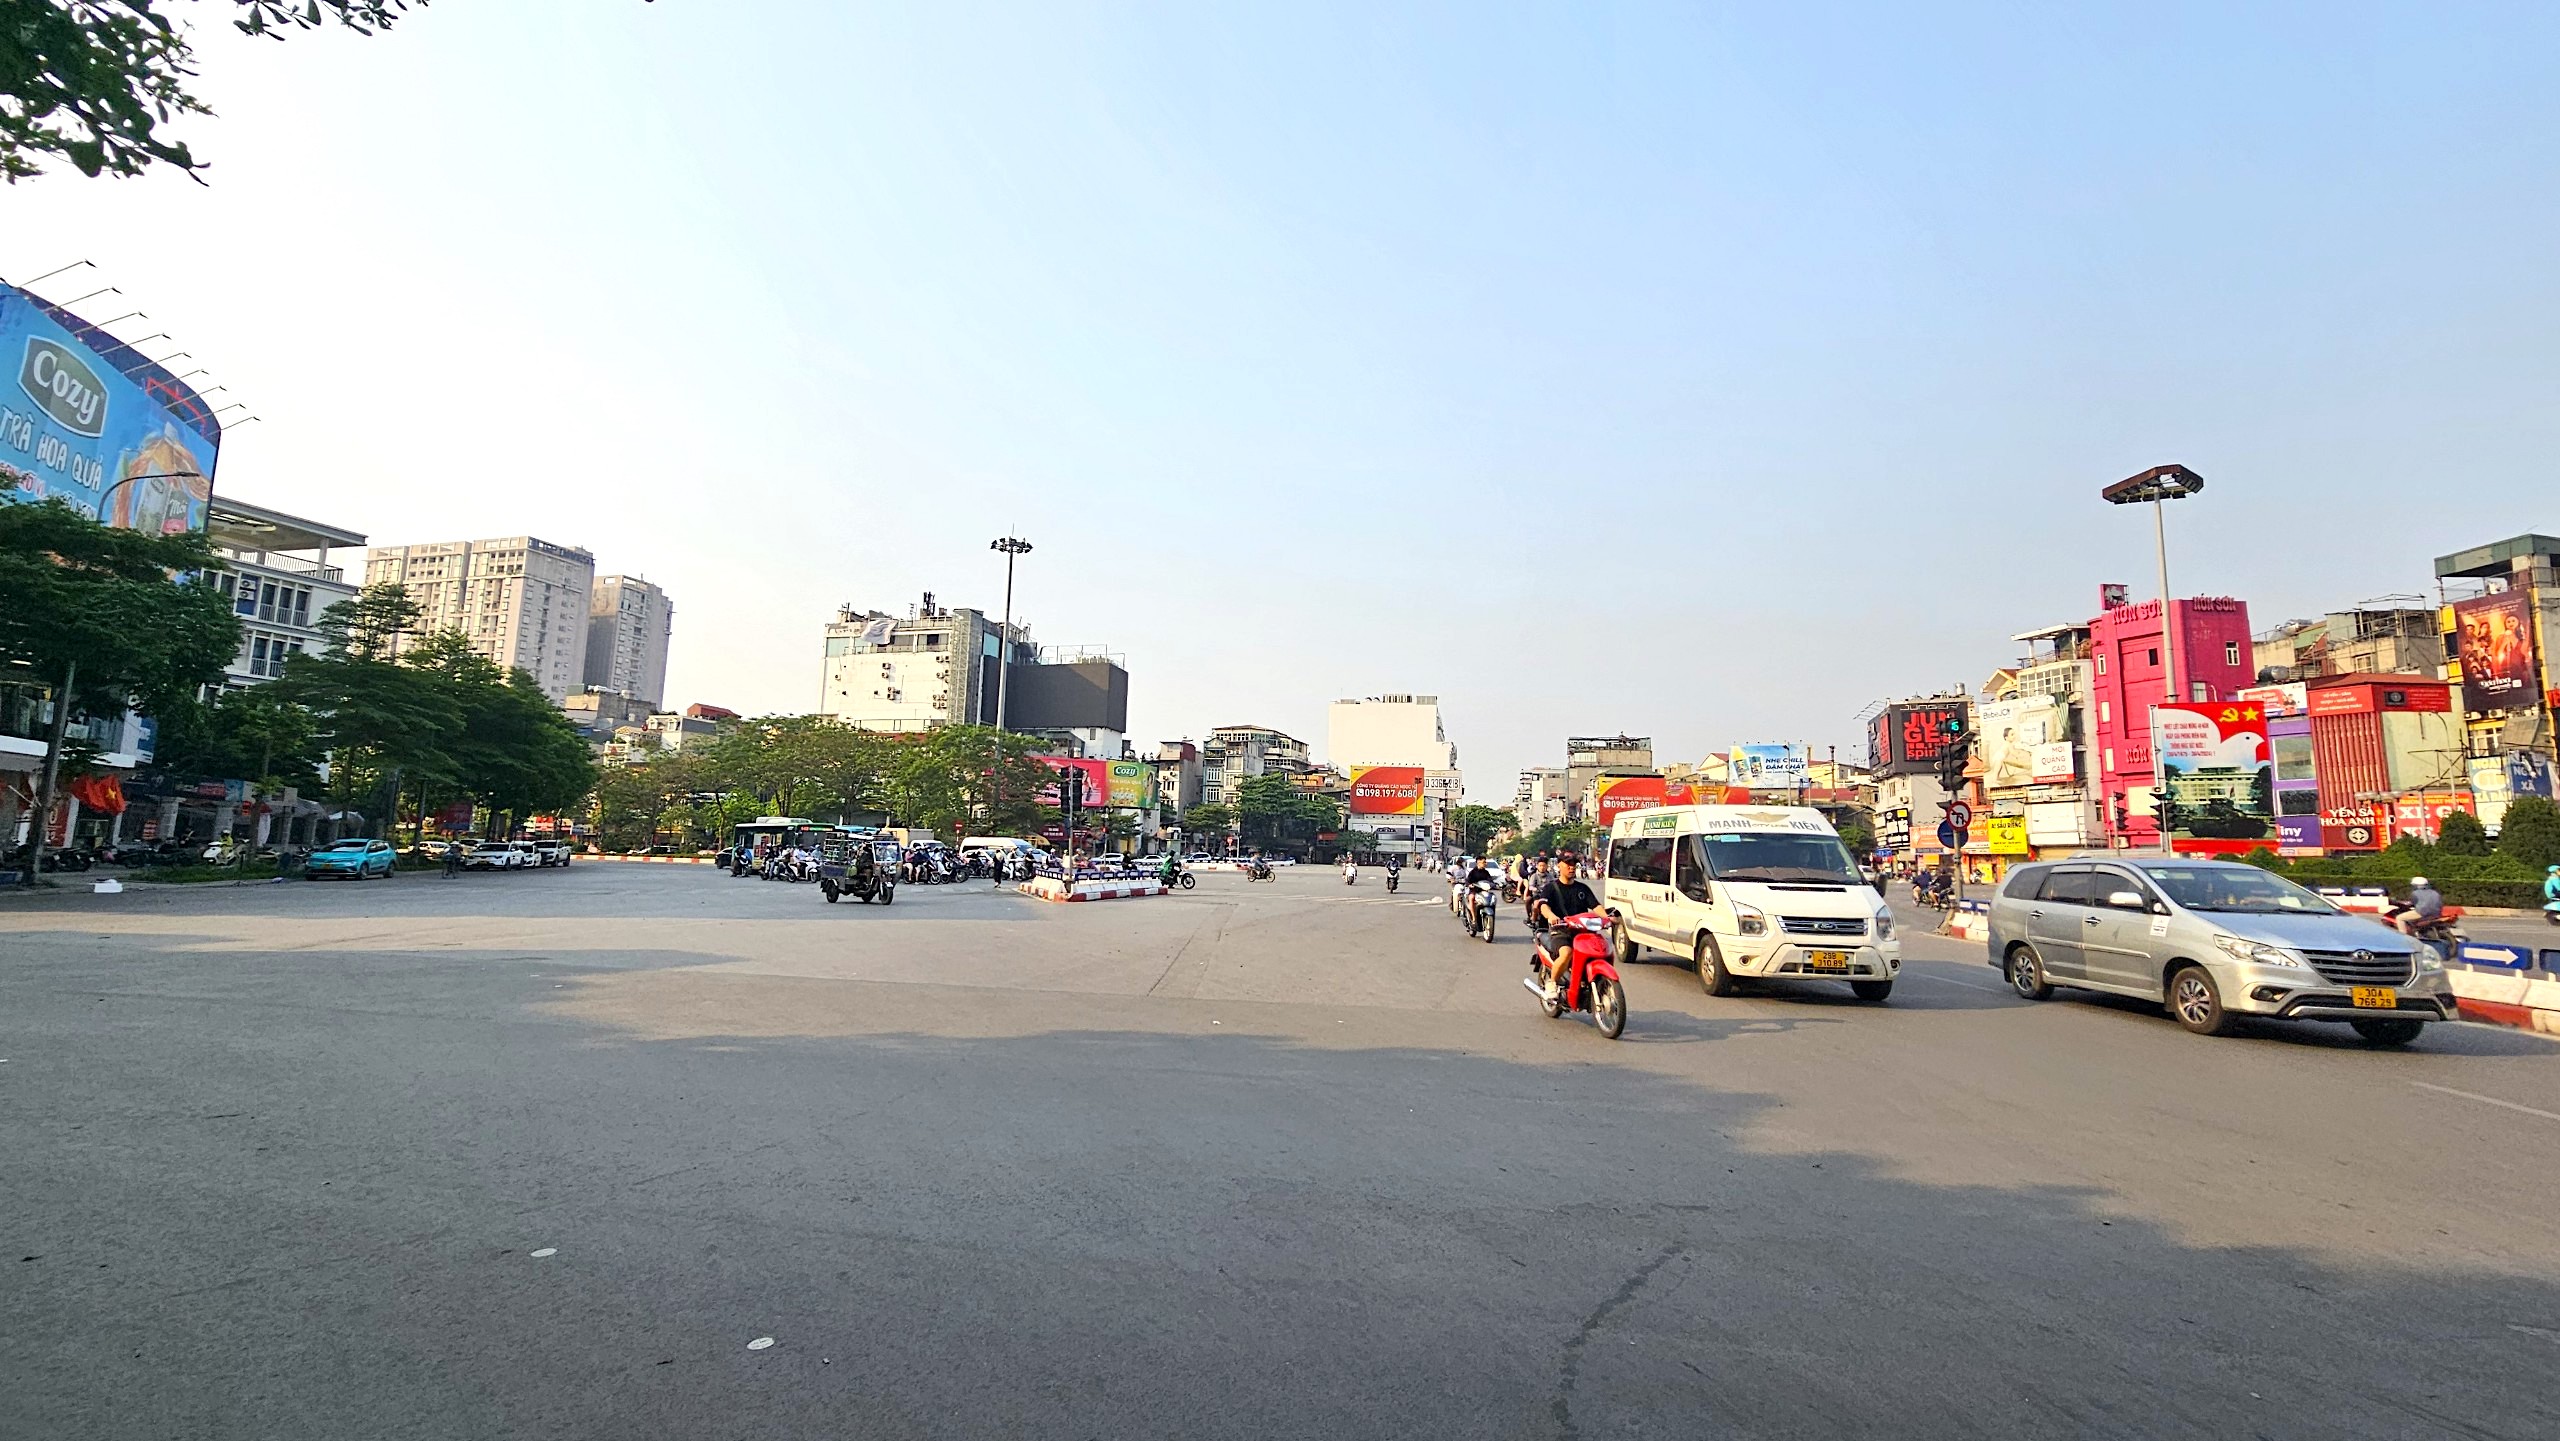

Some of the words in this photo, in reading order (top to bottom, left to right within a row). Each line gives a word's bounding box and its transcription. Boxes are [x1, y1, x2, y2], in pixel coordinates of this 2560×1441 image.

[33, 349, 99, 426] Cozy
[0, 405, 35, 452] TRÀ
[36, 432, 68, 473] HOA
[72, 453, 103, 492] QUẢ
[1115, 766, 1137, 777] Cozy
[2328, 806, 2356, 817] YẾN
[1708, 820, 1752, 830] MẠNH
[2321, 817, 2346, 826] HOA
[2349, 817, 2375, 826] ANH
[2365, 988, 2383, 997] 30A
